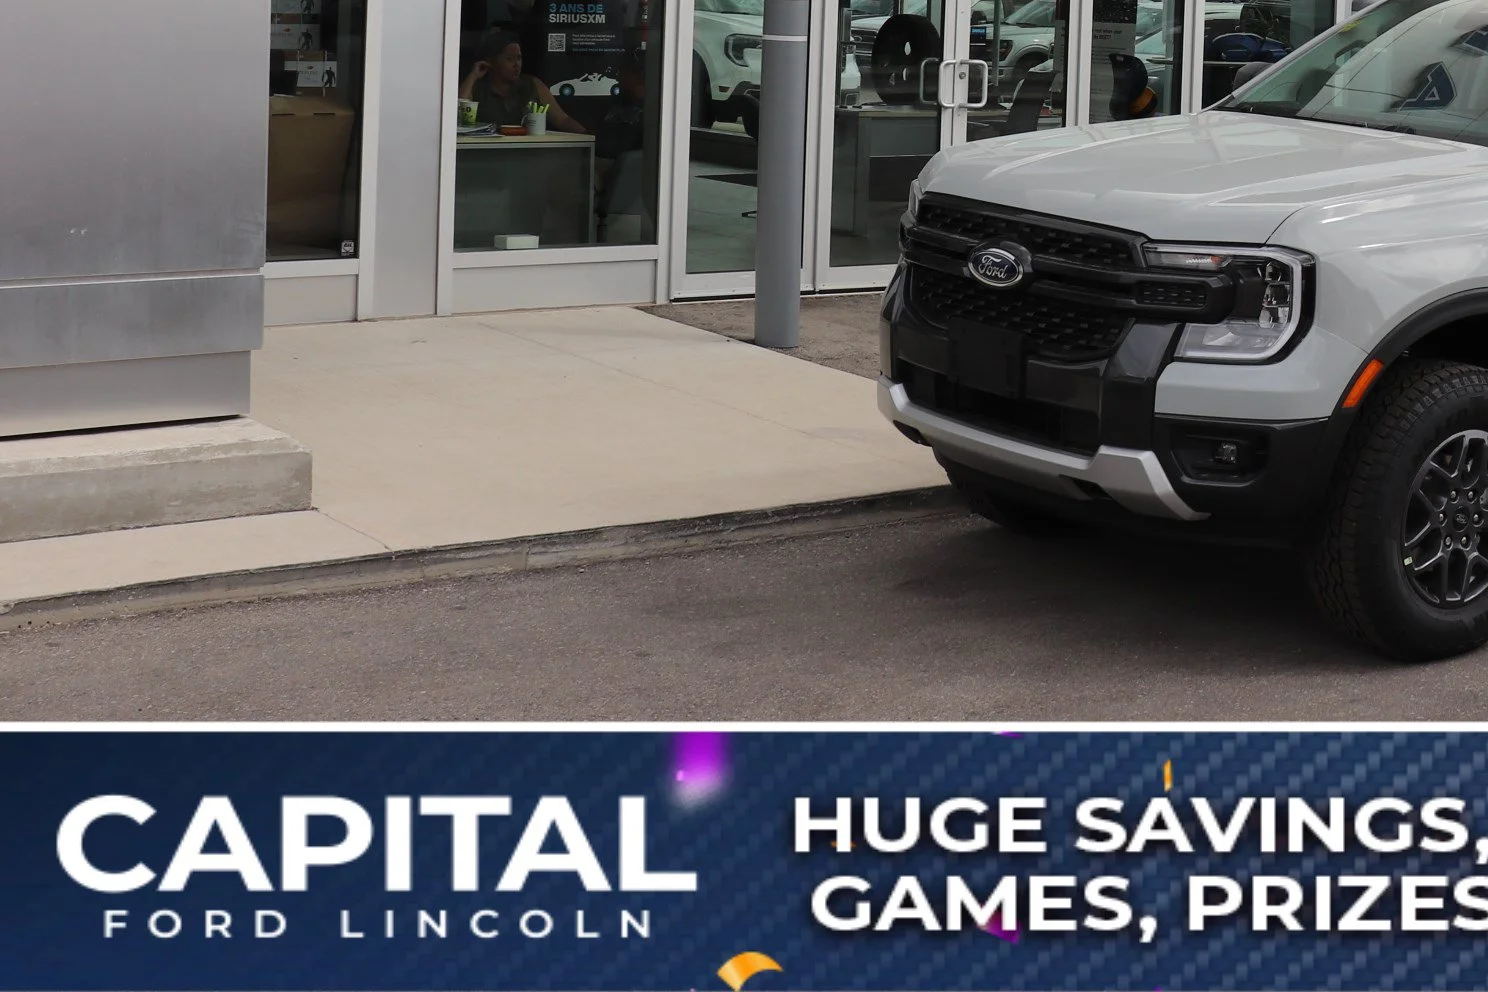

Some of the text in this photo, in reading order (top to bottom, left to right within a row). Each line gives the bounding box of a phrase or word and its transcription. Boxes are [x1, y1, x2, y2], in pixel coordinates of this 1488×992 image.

[549, 3, 604, 13] 3 ANS DE
[548, 13, 606, 24] SIRIUSXM
[978, 254, 1009, 279] Ford
